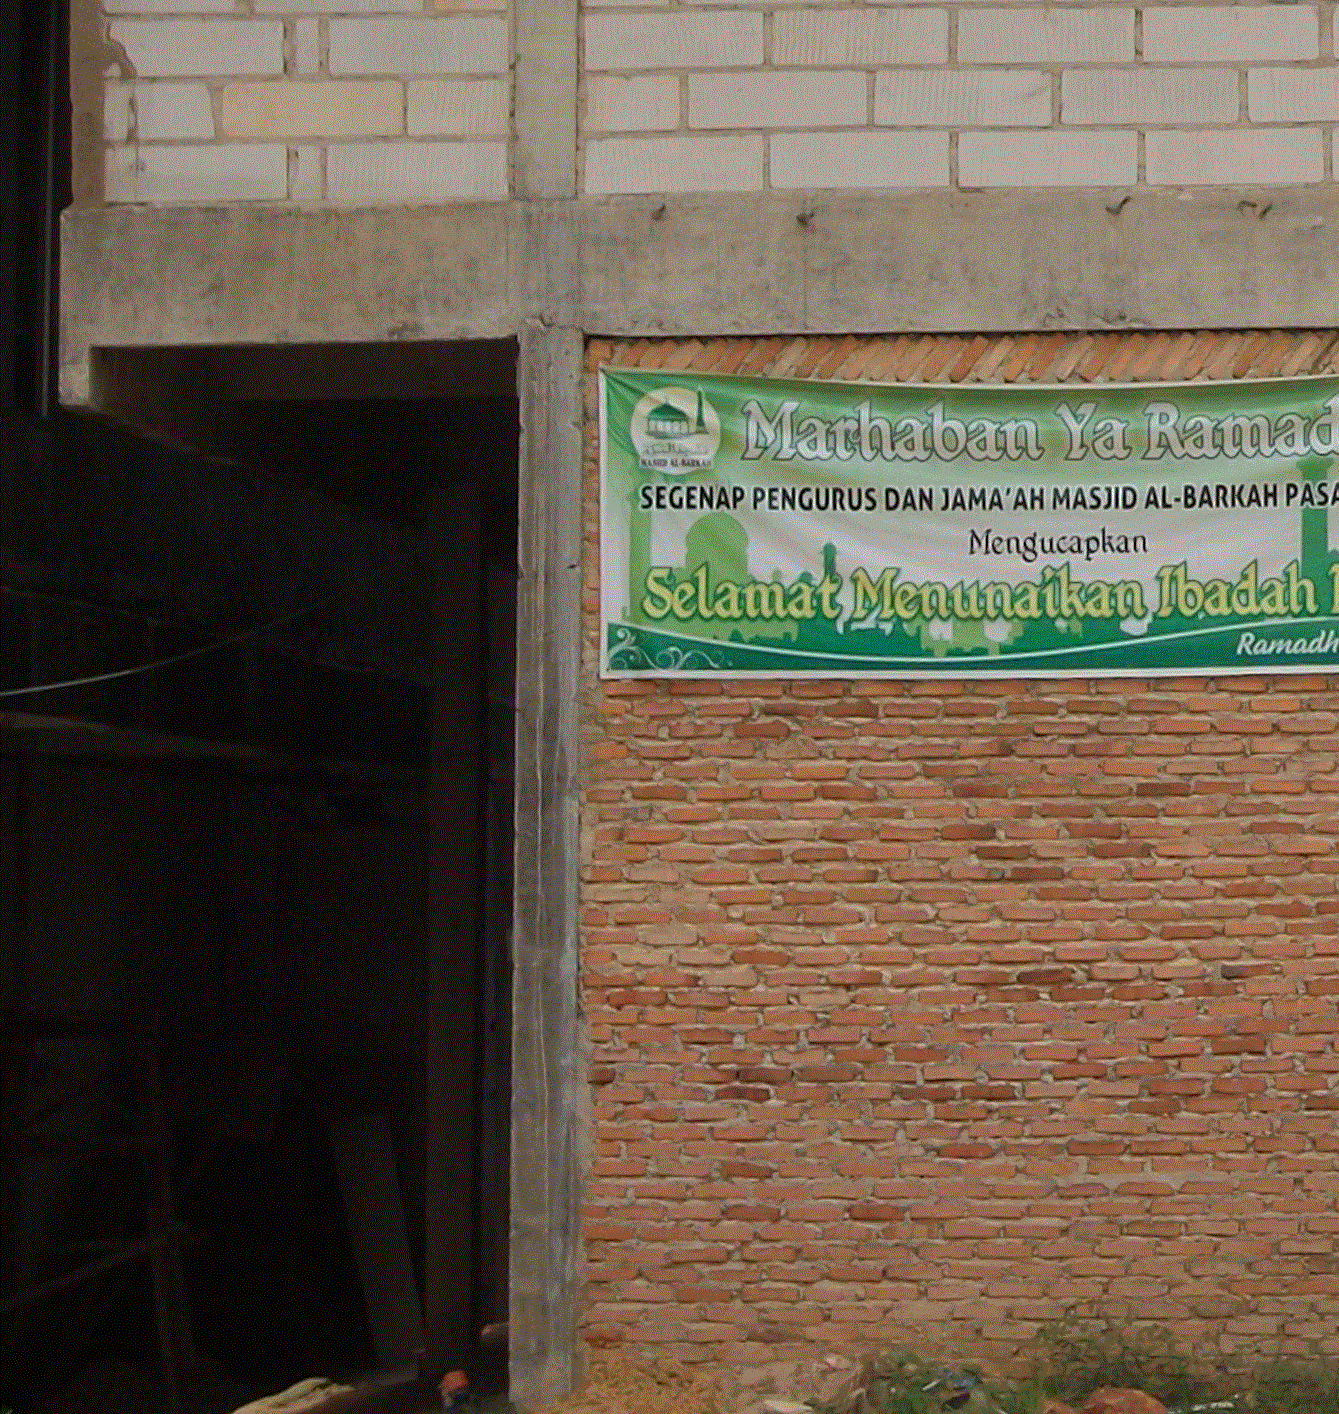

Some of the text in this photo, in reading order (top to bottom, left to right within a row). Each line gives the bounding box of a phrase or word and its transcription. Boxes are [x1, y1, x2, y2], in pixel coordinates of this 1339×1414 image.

[740, 399, 1045, 463] Marhaban
[1054, 399, 1132, 462] Ya
[640, 485, 745, 511] SEGENAP
[752, 486, 877, 512] PENGURUS
[884, 487, 933, 512] DAN
[1052, 486, 1137, 511] MASJID
[1143, 483, 1278, 511] AL-BARKAH
[969, 527, 1149, 563] Mengucapkan
[642, 564, 844, 621] Selamat
[849, 562, 1146, 621] Menunaikan
[1154, 559, 1319, 619] Ibadah
